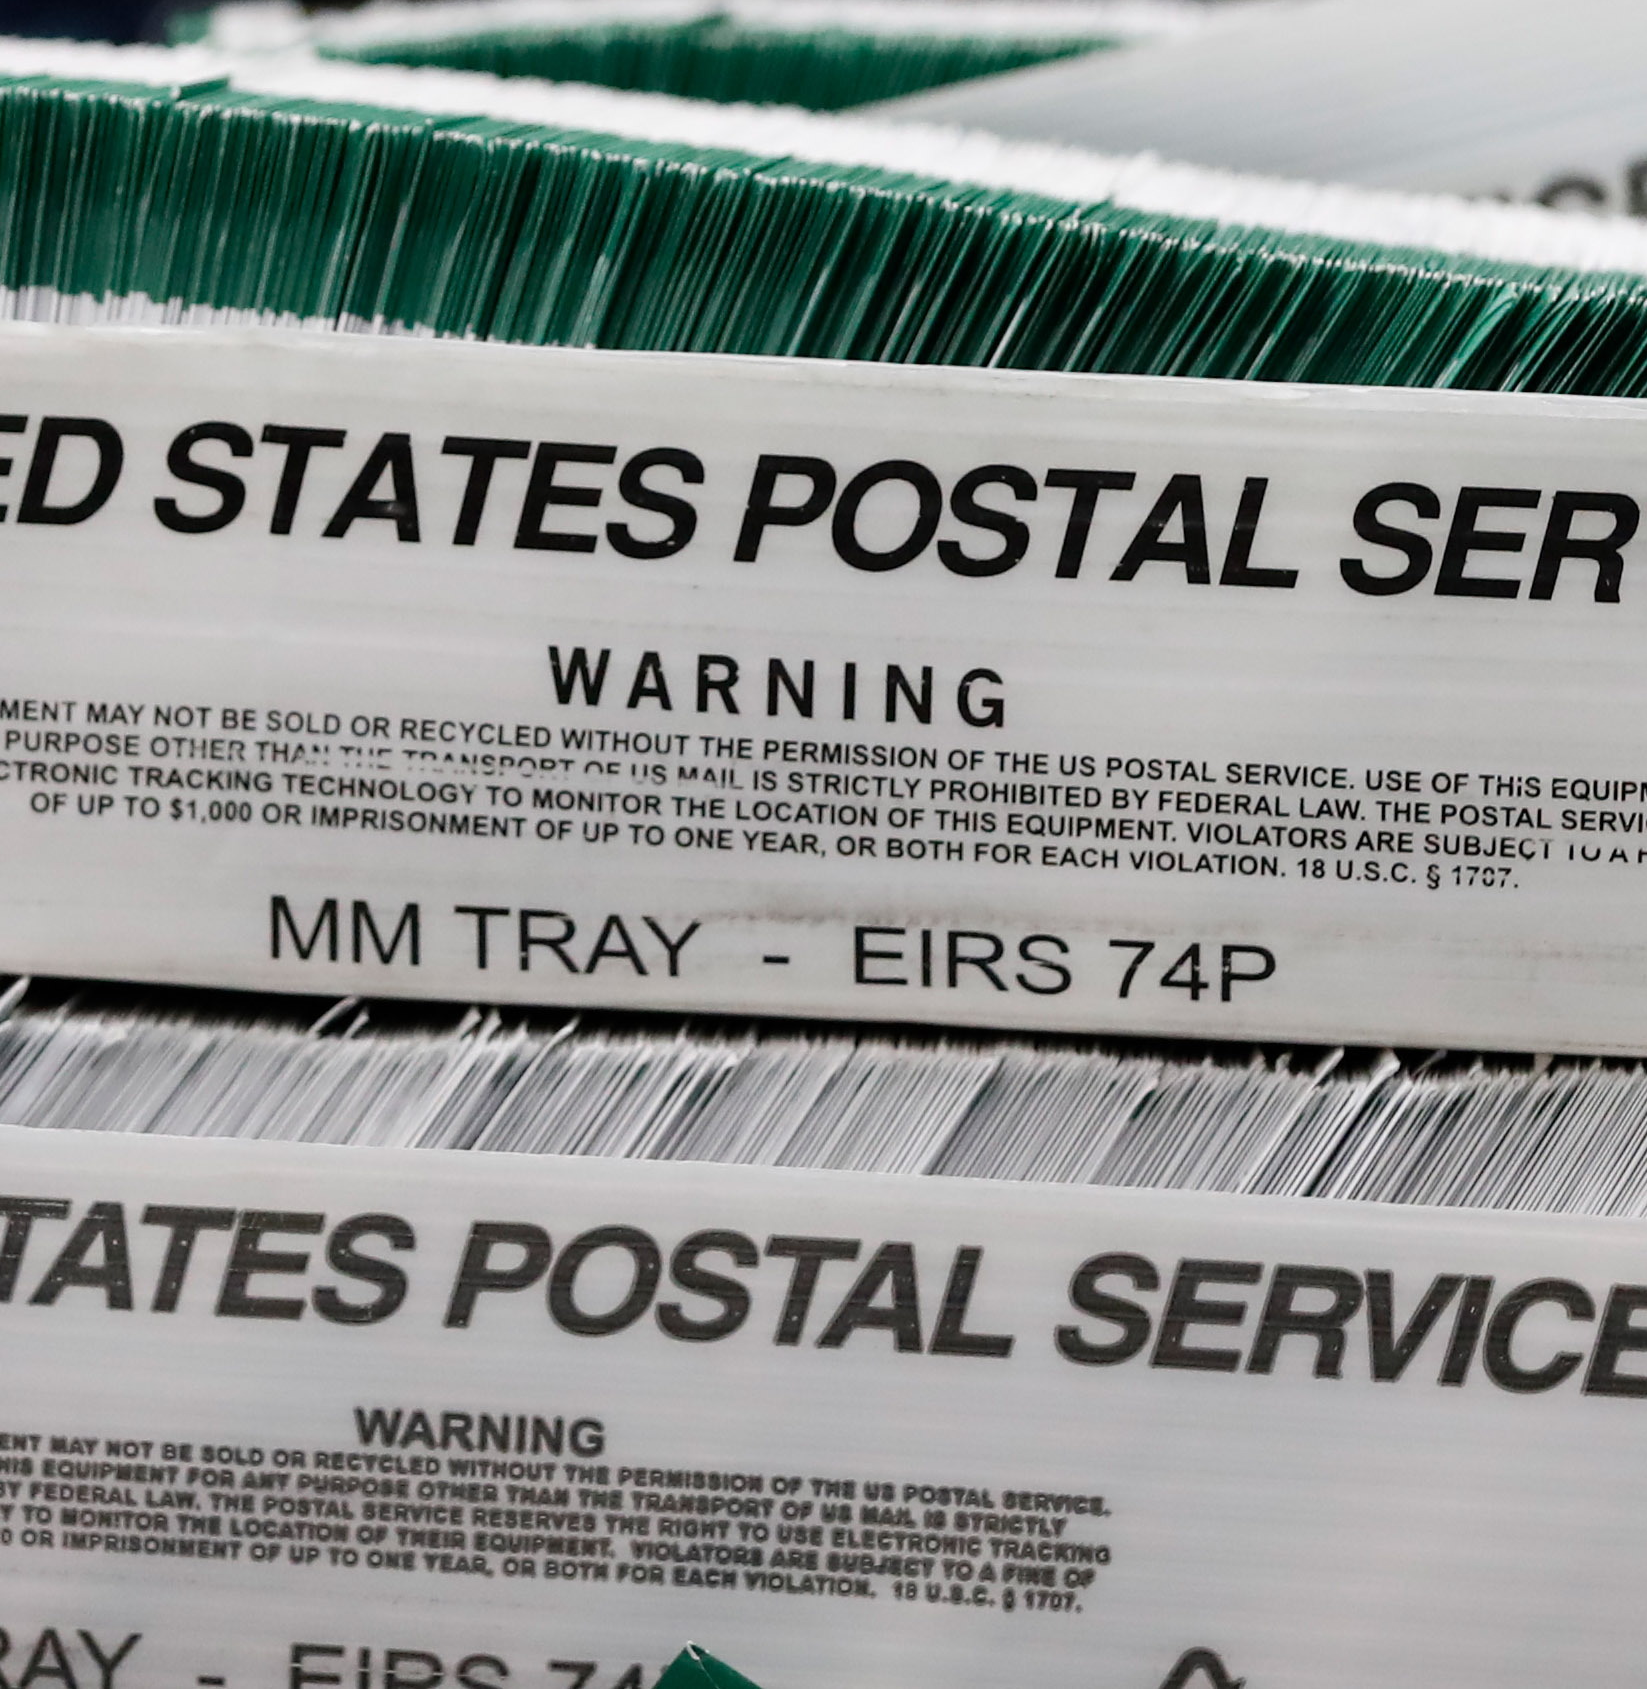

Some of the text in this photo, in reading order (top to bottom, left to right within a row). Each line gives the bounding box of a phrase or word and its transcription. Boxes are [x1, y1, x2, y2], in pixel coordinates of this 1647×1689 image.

[152, 420, 706, 562] STATES
[732, 453, 1300, 590] POSTAL
[546, 644, 1006, 729] WARNING
[4, 729, 141, 757] PURPOSE
[149, 735, 247, 762] OTHER
[752, 769, 779, 793] IS
[786, 771, 923, 800] STRICTLY
[929, 778, 1103, 809] PROHIBITED
[1111, 787, 1151, 811] BY
[1157, 789, 1291, 818] FEDERAL
[1298, 796, 1366, 822] LAW.
[1374, 800, 1432, 825] THE
[1439, 803, 1553, 830] POSTAL
[86, 702, 146, 726] MAY
[153, 705, 213, 729] NOT
[220, 707, 257, 732] BE
[265, 709, 342, 736] SOLD
[349, 714, 391, 739] OR
[399, 717, 553, 749] RECYCLED
[560, 727, 691, 757] WITHOUT
[698, 735, 754, 761] THE
[762, 739, 938, 770] PERMISSION
[946, 748, 987, 772] OF
[993, 750, 1050, 776] THE
[1058, 754, 1097, 778] US
[1105, 756, 1218, 784] POSTAL
[1224, 761, 1355, 790] SERVICE.
[1364, 768, 1423, 794] USE
[1430, 771, 1470, 795] OF
[29, 791, 68, 815] OF
[76, 794, 115, 816] UP
[122, 795, 162, 819] TO
[169, 796, 254, 824] $1,000
[260, 802, 303, 826] OR
[310, 804, 529, 839] IMPRISONMENT
[534, 818, 574, 842] OF
[581, 820, 621, 844] UP
[627, 823, 667, 847] TO
[673, 826, 735, 851] ONE
[741, 829, 827, 858] YEAR,
[835, 834, 878, 858] OR
[885, 837, 965, 862] BOTH
[973, 841, 1033, 866] FOR
[1040, 845, 1120, 870] EACH
[1128, 849, 1287, 878] VIOLATION.
[1296, 857, 1327, 880] 18
[1335, 859, 1417, 884] U.S.C.
[1425, 863, 1442, 891] §
[127, 765, 274, 794] TRACKING
[280, 772, 478, 805] TECHNOLOGY
[484, 784, 524, 808] TO
[531, 787, 663, 817] MONITOR
[669, 795, 727, 820] THE
[734, 799, 879, 828] LOCATION
[886, 806, 926, 830] OF
[933, 808, 998, 834] THIS
[1006, 812, 1177, 843] EQUIPMENT.
[1185, 821, 1348, 851] VIOLATORS
[1354, 829, 1415, 854] ARE
[1422, 832, 1555, 862] SUBJECT
[270, 894, 421, 967] MM
[453, 904, 702, 978] TRAY
[853, 924, 1073, 996] EIRS
[1108, 938, 1277, 1004] 74P
[442, 1220, 1015, 1360] POSTAL
[49, 1437, 100, 1455] MAY
[104, 1440, 155, 1459] NOT
[159, 1443, 194, 1463] BE
[200, 1445, 266, 1467] SOLD
[271, 1449, 307, 1469] OR
[312, 1451, 442, 1476] RECYCLED
[446, 1459, 558, 1482] WITHOUT
[562, 1463, 611, 1486] THE
[616, 1466, 765, 1493] PERMISSION
[902, 1484, 996, 1509] POSTAL
[353, 1405, 607, 1458] WARNING
[28, 1482, 138, 1506] FEDERAL
[144, 1490, 201, 1509] LAW.
[208, 1492, 256, 1514] THE
[261, 1496, 355, 1520] POSTAL
[361, 1502, 465, 1526] SERVICE
[470, 1507, 597, 1533] RESERVES
[603, 1514, 651, 1536] THE
[657, 1517, 732, 1539] RIGHT
[736, 1521, 771, 1543] TO
[775, 1525, 825, 1547] USE
[830, 1527, 983, 1558] ELECTRONIC
[987, 1537, 1112, 1566] TRACKING
[40, 1458, 499, 1503] EQUIPMENT FOR PURPOSE OTHER
[20, 1504, 54, 1525] TO
[59, 1508, 170, 1532] MONITOR
[175, 1514, 222, 1536] THE
[228, 1518, 350, 1542] LOCATION
[355, 1525, 389, 1545] OF
[395, 1528, 467, 1550] THEIR
[472, 1532, 616, 1558] EQUIPMENT.
[629, 1541, 765, 1567] VIOLATORS
[20, 1529, 55, 1548] OR
[61, 1532, 243, 1559] IMPRISONMENT
[248, 1543, 283, 1561] OF
[288, 1546, 321, 1564] UP
[327, 1547, 360, 1567] TO
[365, 1550, 416, 1571] ONE
[421, 1553, 495, 1576] YEAR,
[501, 1557, 537, 1577] OR
[542, 1559, 610, 1579] BOTH
[615, 1562, 665, 1584] FOR
[671, 1566, 739, 1588] EACH
[742, 1572, 877, 1597] VIOLATION.
[892, 1581, 919, 1601] 18
[1023, 1590, 1083, 1611] 1707.
